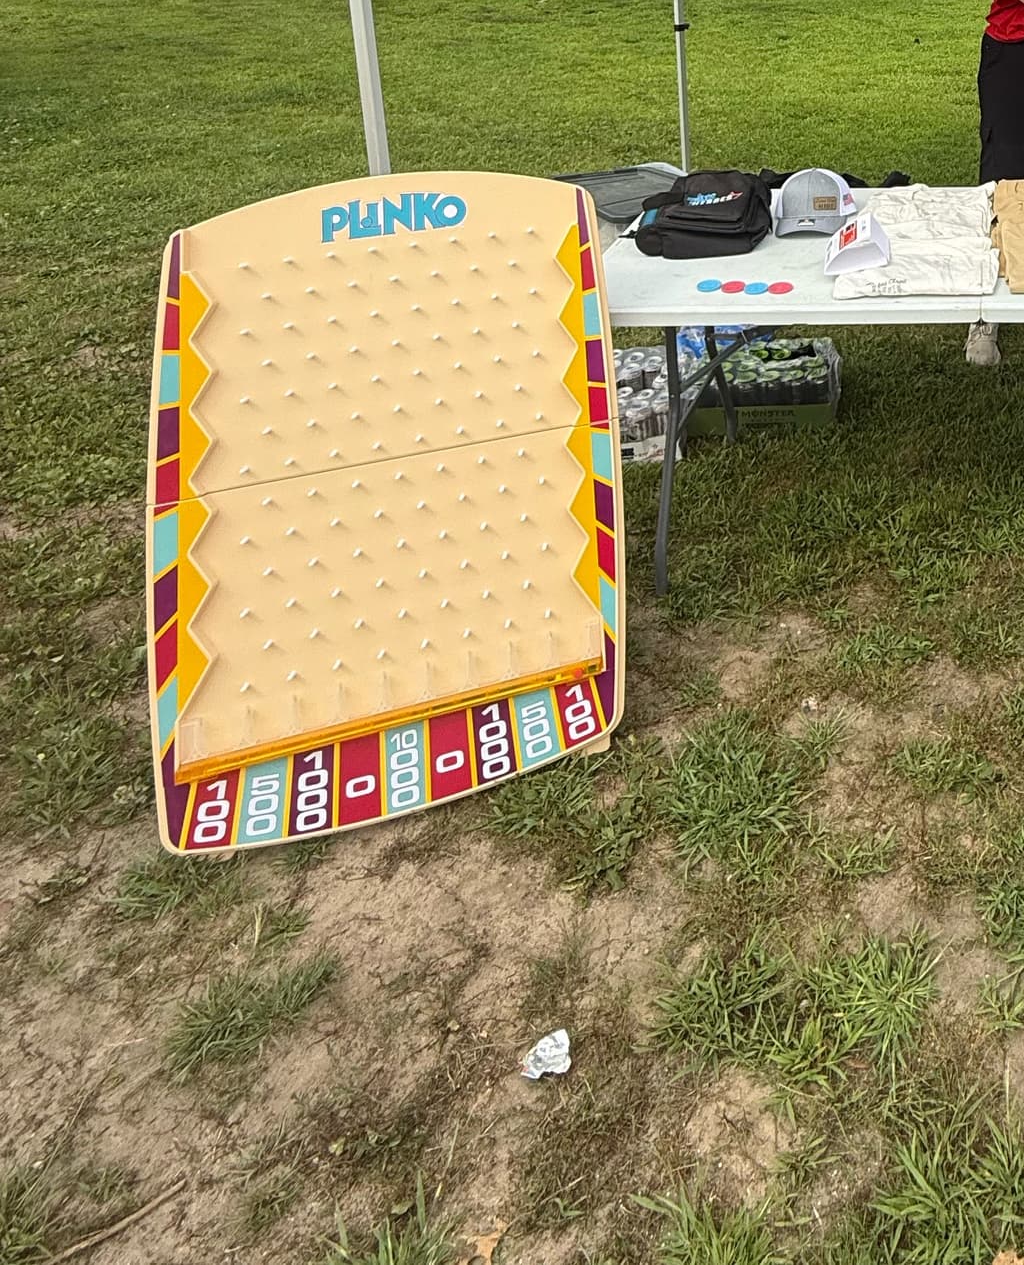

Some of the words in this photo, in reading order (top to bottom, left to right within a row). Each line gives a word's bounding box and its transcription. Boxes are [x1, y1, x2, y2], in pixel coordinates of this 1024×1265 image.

[321, 192, 467, 243] PLINKO
[435, 749, 465, 774] 0
[345, 774, 376, 799] 0
